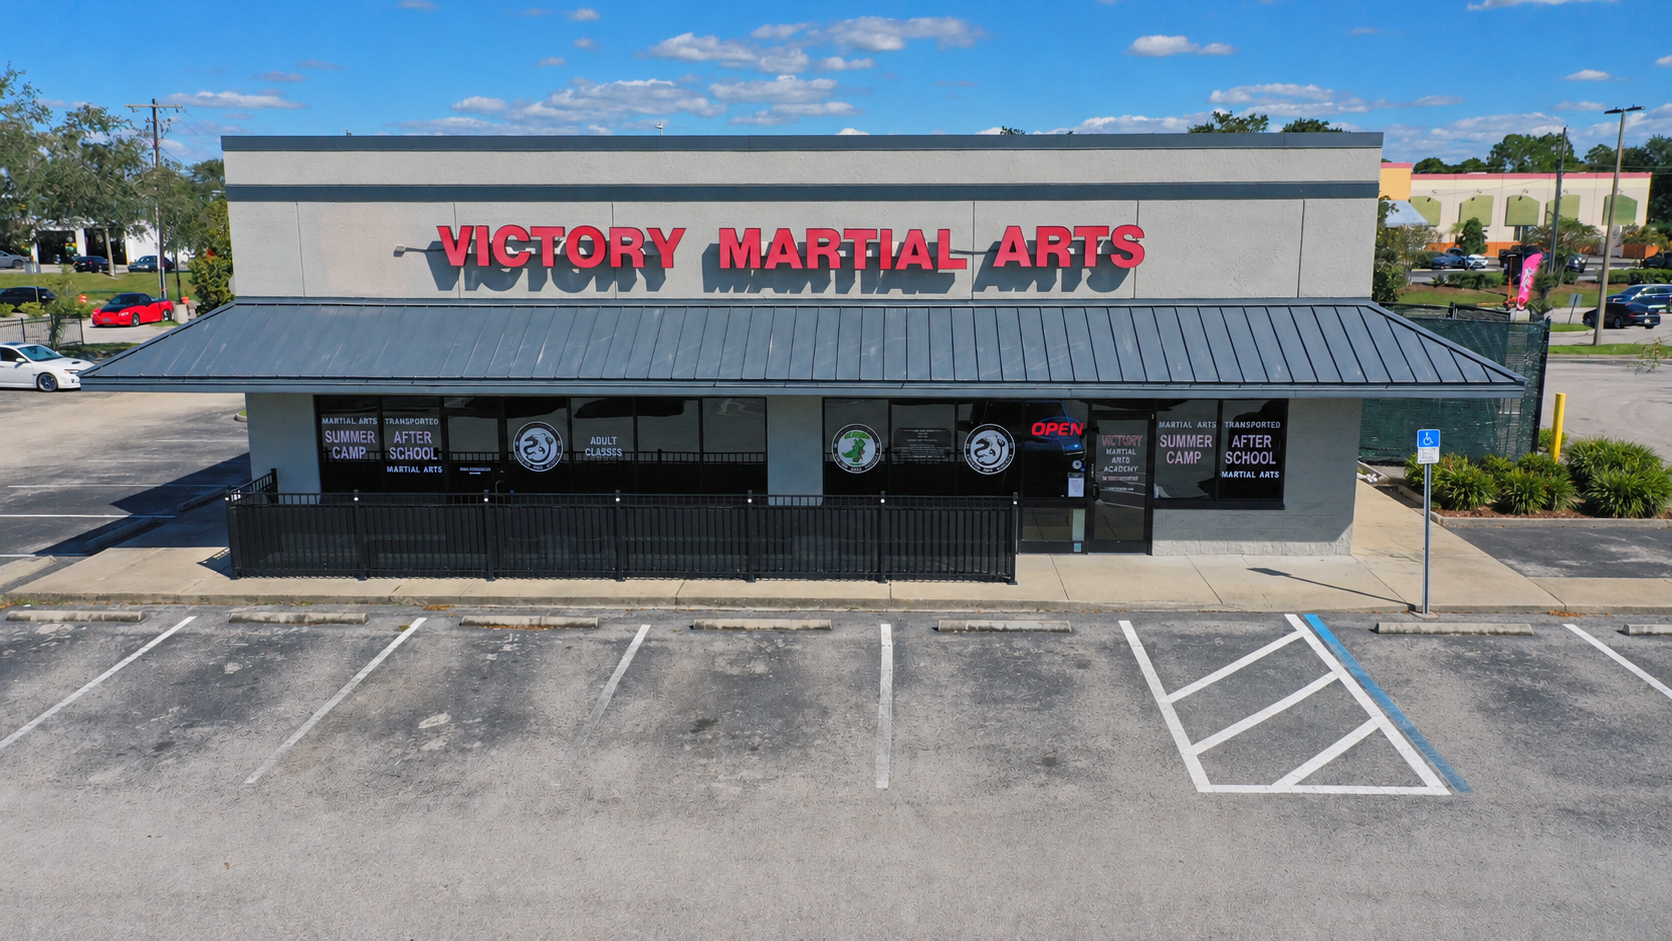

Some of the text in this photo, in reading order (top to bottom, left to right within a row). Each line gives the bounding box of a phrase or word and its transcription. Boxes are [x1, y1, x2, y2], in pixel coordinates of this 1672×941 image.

[436, 224, 1146, 271] VICTORY MARTIAL ARTS
[321, 417, 378, 425] MARTIAL ARTS
[1158, 421, 1217, 429] MARTIAL ARTS
[1224, 421, 1281, 429] TRANSPORTED
[1031, 422, 1084, 436] OPEN
[324, 430, 376, 444] SUMMER
[393, 430, 433, 444] AFTER
[590, 436, 618, 445] ADULT
[1101, 434, 1143, 446] VICTORY
[1159, 434, 1213, 448] SUMMER
[1231, 434, 1272, 448] AFTER
[332, 446, 367, 460] CAMP
[389, 446, 438, 461] SCHOOL
[585, 447, 623, 457] CLASSES
[1166, 450, 1202, 465] CAMP
[1225, 450, 1276, 465] SCHOOL
[1111, 456, 1131, 464] ARTS
[386, 465, 443, 473] MARTIAL ARTS
[1103, 465, 1139, 473] ACADEMY
[1220, 470, 1280, 479] MARTIAL ARTS
